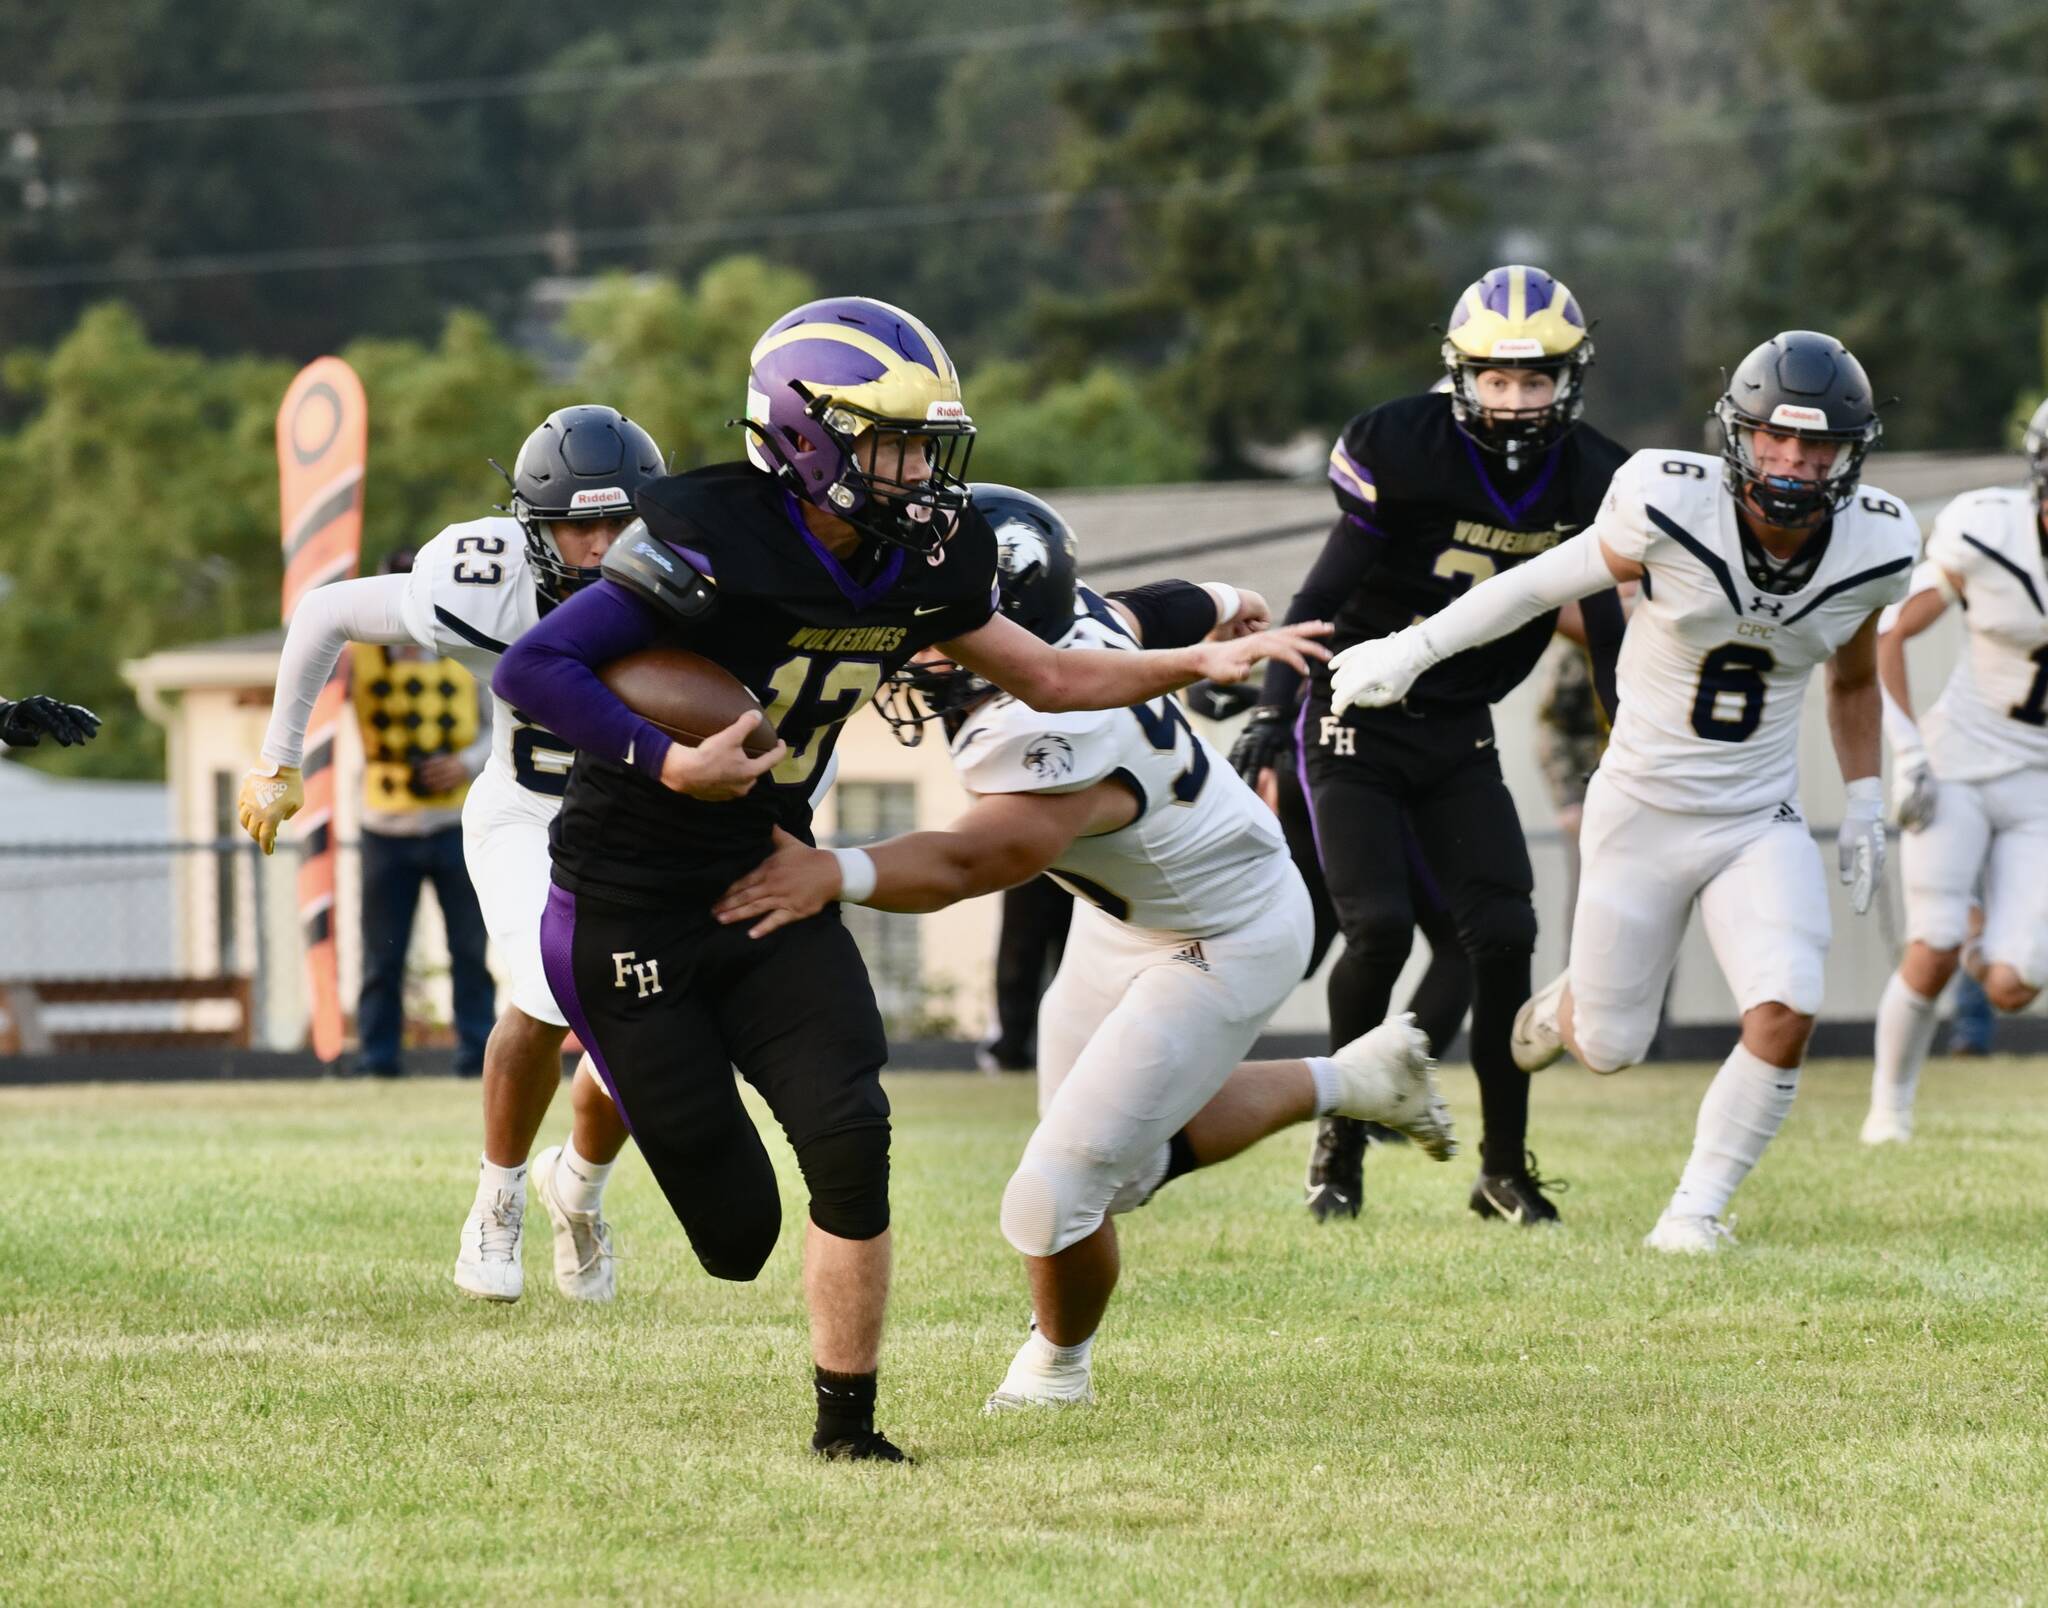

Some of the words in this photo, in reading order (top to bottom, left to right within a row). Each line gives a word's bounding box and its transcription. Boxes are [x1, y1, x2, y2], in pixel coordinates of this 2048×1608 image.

[1661, 460, 1706, 481] 6
[578, 491, 621, 504] Riddell
[1861, 496, 1901, 519] 6
[453, 535, 508, 588] 23
[787, 626, 908, 652] WOLVERINES
[1736, 622, 1777, 640] CPC
[1689, 640, 1777, 743] 6
[1318, 715, 1357, 756] FH
[611, 951, 663, 998] FH
